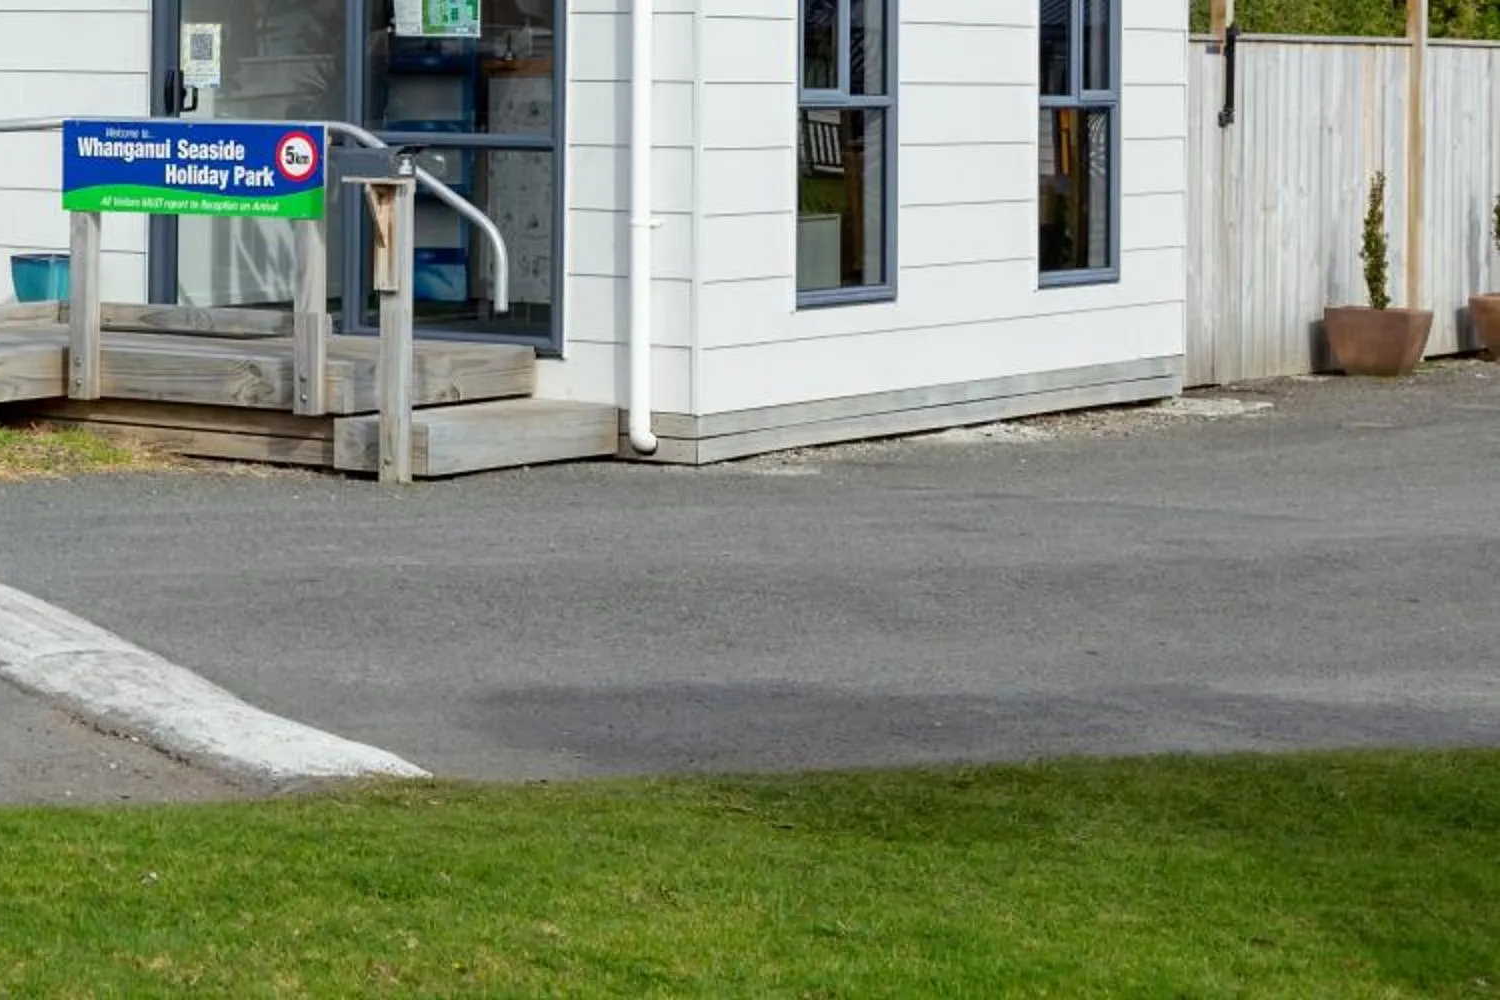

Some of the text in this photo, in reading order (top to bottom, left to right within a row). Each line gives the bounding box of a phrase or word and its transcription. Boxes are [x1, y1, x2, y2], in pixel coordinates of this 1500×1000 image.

[77, 137, 245, 162] Whanganui Seaside
[165, 164, 274, 189] Holiday Park
